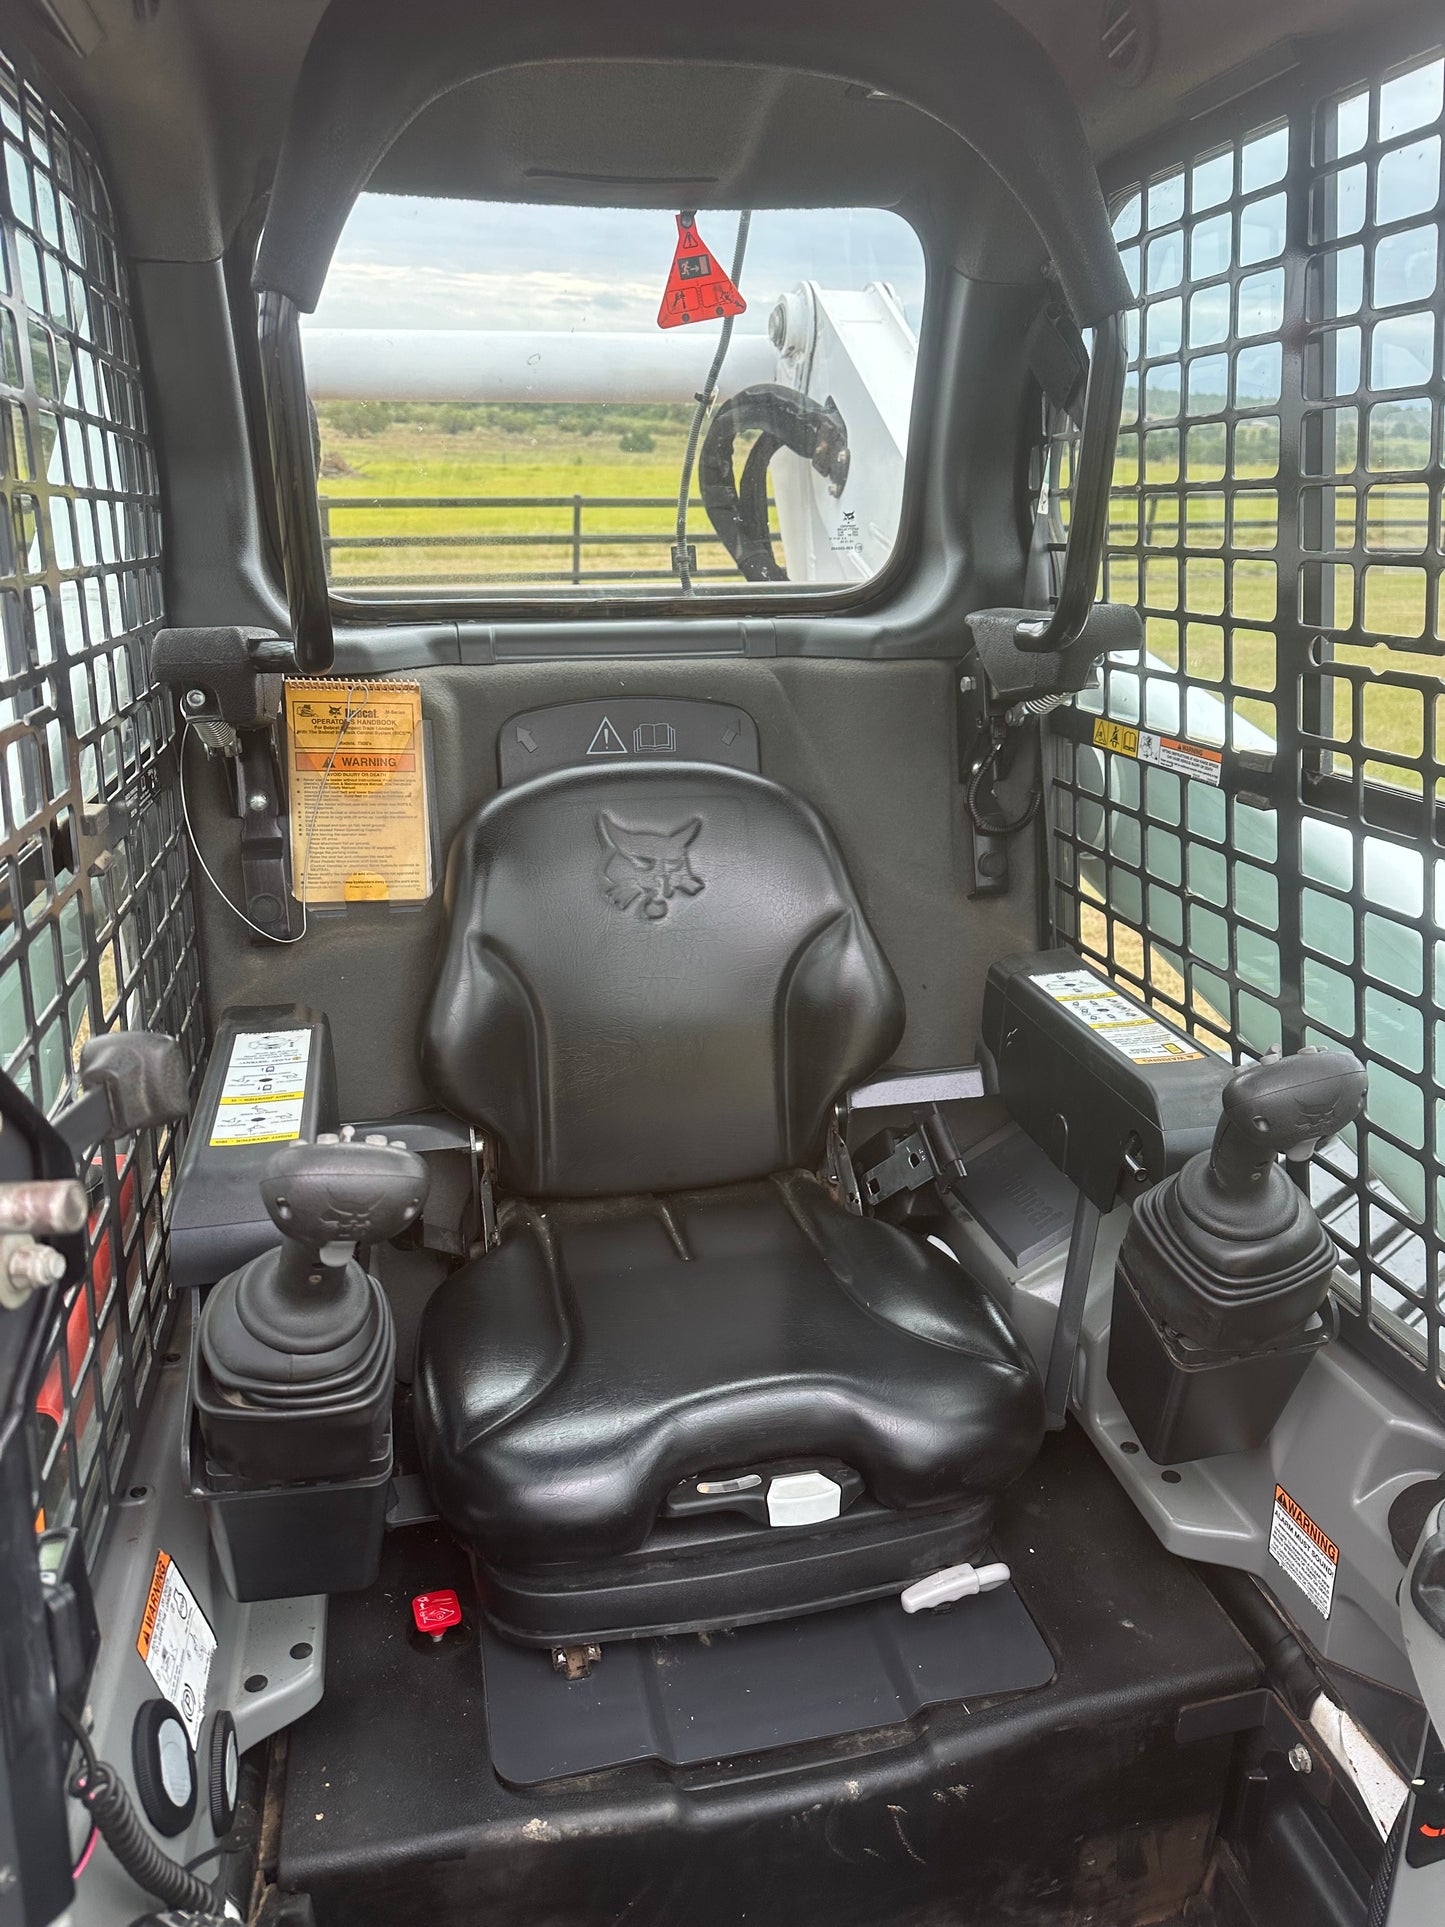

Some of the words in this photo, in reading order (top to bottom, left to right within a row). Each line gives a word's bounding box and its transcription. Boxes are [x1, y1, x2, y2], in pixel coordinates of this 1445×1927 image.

[342, 757, 397, 766] WARNING
[1274, 1508, 1293, 1534] ALARM
[1294, 1530, 1310, 1553] MUST
[1287, 1499, 1336, 1561] WARNING
[144, 1560, 166, 1630] WARNING
